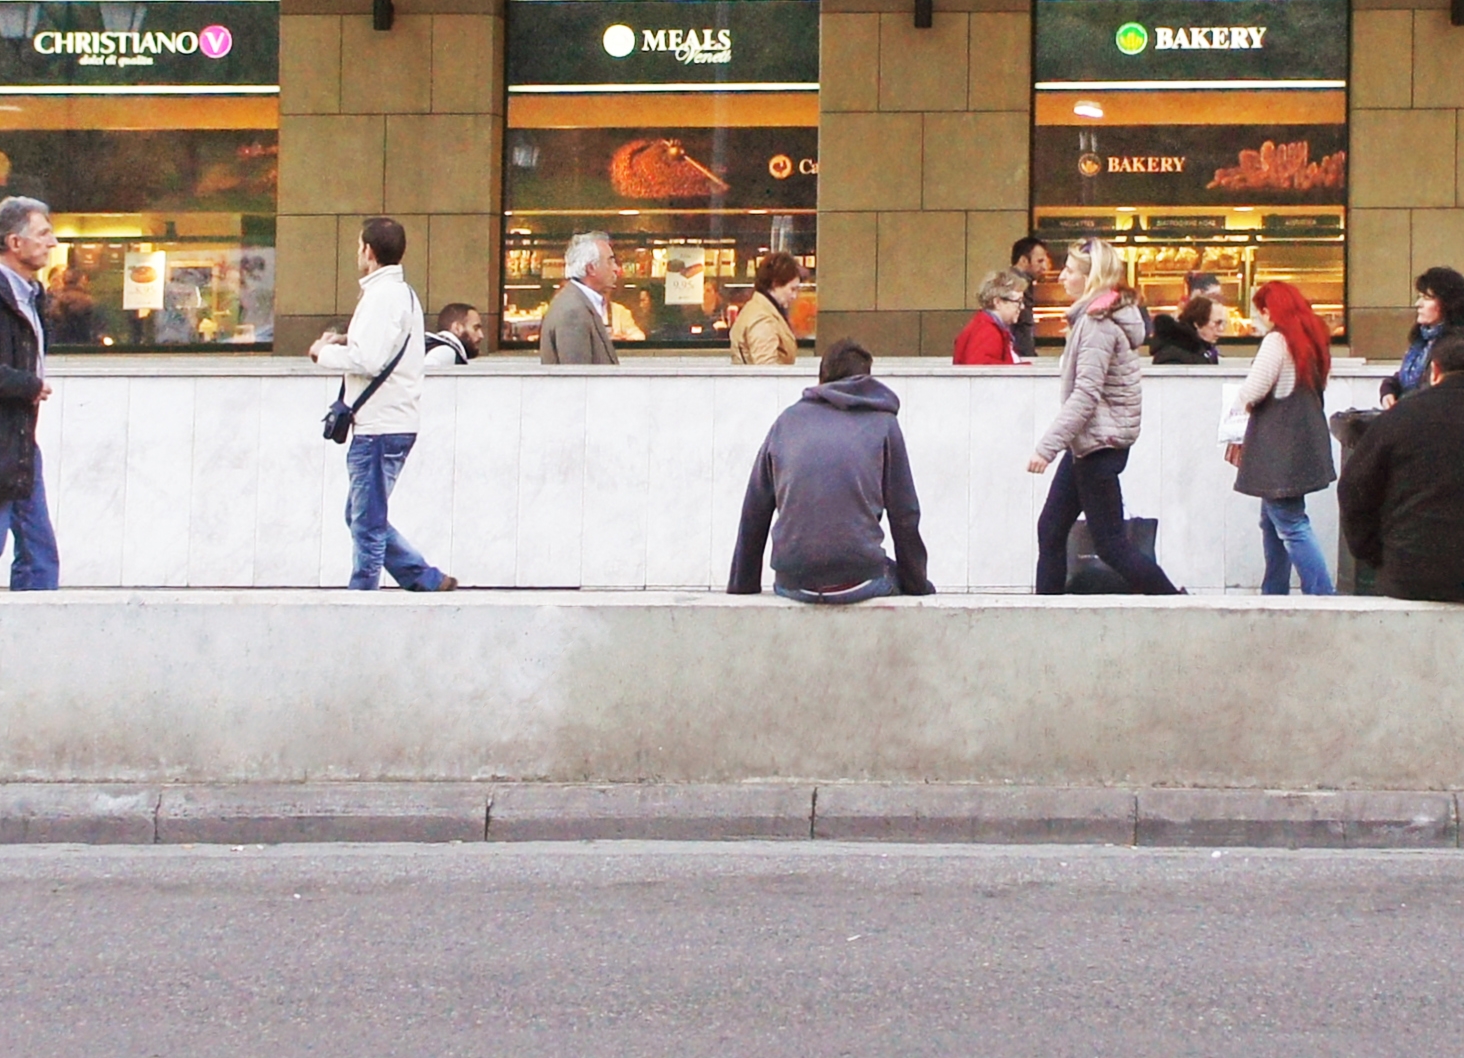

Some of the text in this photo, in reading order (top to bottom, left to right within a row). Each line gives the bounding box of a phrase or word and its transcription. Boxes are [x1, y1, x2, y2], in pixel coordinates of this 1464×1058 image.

[33, 31, 200, 55] CHRISTIANO
[641, 28, 732, 52] MEALS
[1154, 26, 1267, 50] BAKERY
[798, 158, 819, 175] Ca
[1107, 156, 1186, 173] BAKERY
